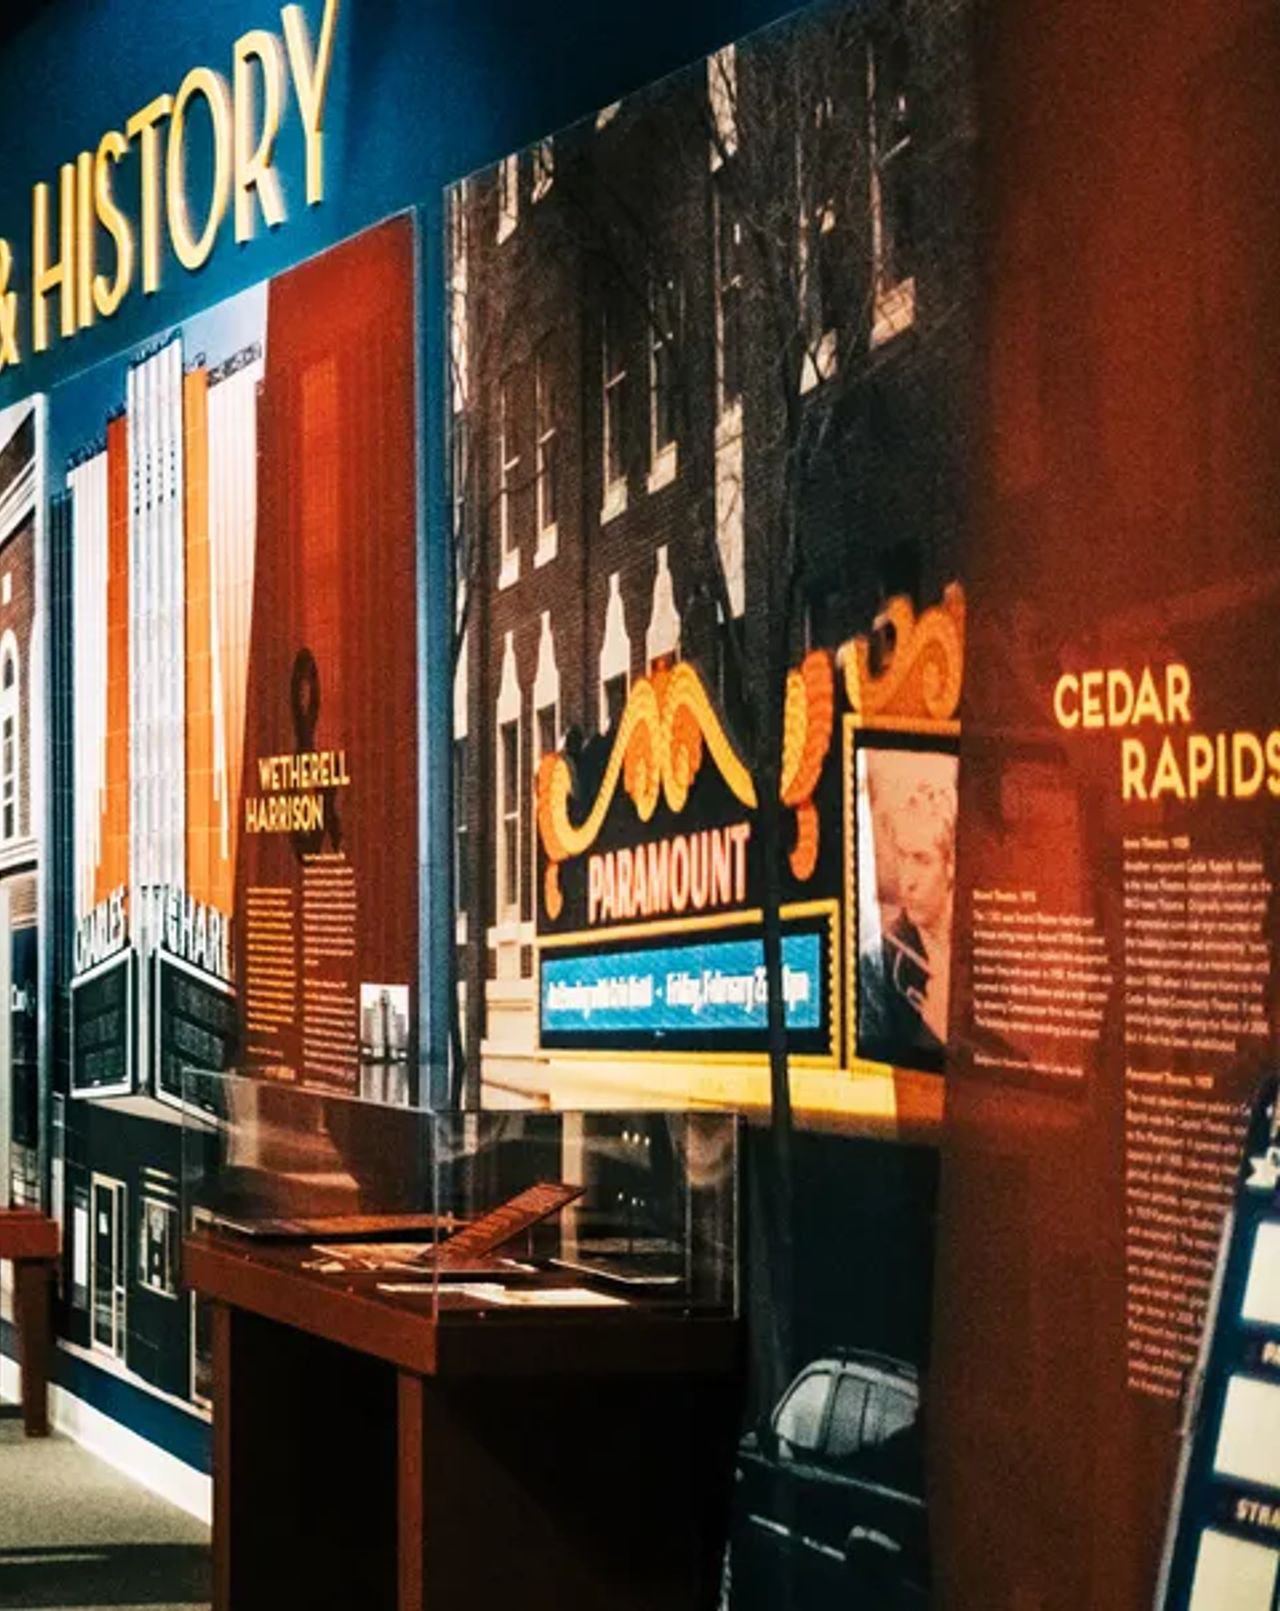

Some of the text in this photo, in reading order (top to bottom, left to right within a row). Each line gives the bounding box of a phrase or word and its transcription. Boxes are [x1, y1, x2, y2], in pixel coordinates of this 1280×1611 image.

[32, 0, 340, 353] HISTORY
[1053, 663, 1192, 730] CEDAR
[258, 749, 351, 791] WETHERELL
[1121, 730, 1280, 801] RAPIDS
[245, 793, 325, 833] HARRISON
[588, 820, 752, 925] PARAMOUNT
